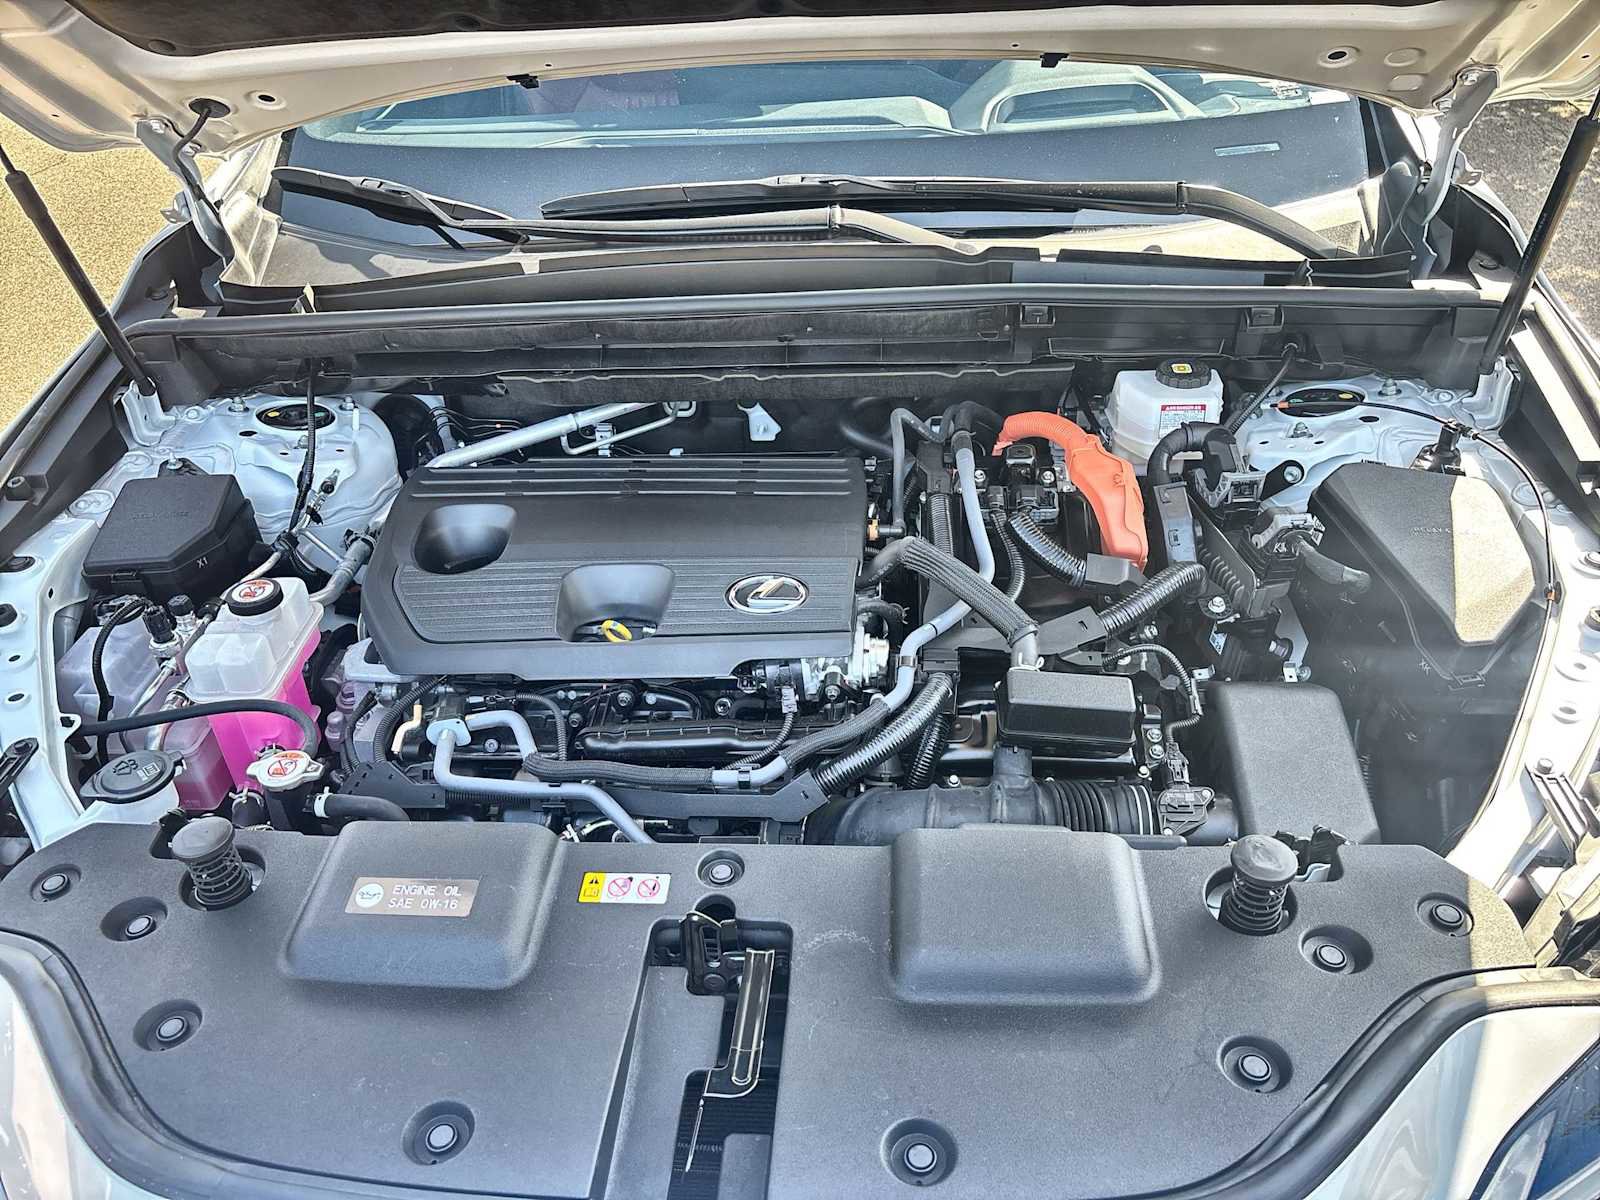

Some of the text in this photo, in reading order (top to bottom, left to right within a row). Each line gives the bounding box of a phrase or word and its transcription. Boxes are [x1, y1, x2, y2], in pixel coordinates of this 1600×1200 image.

[392, 885, 462, 897] ENGINE OIL
[388, 898, 458, 910] SAE 0W-16
